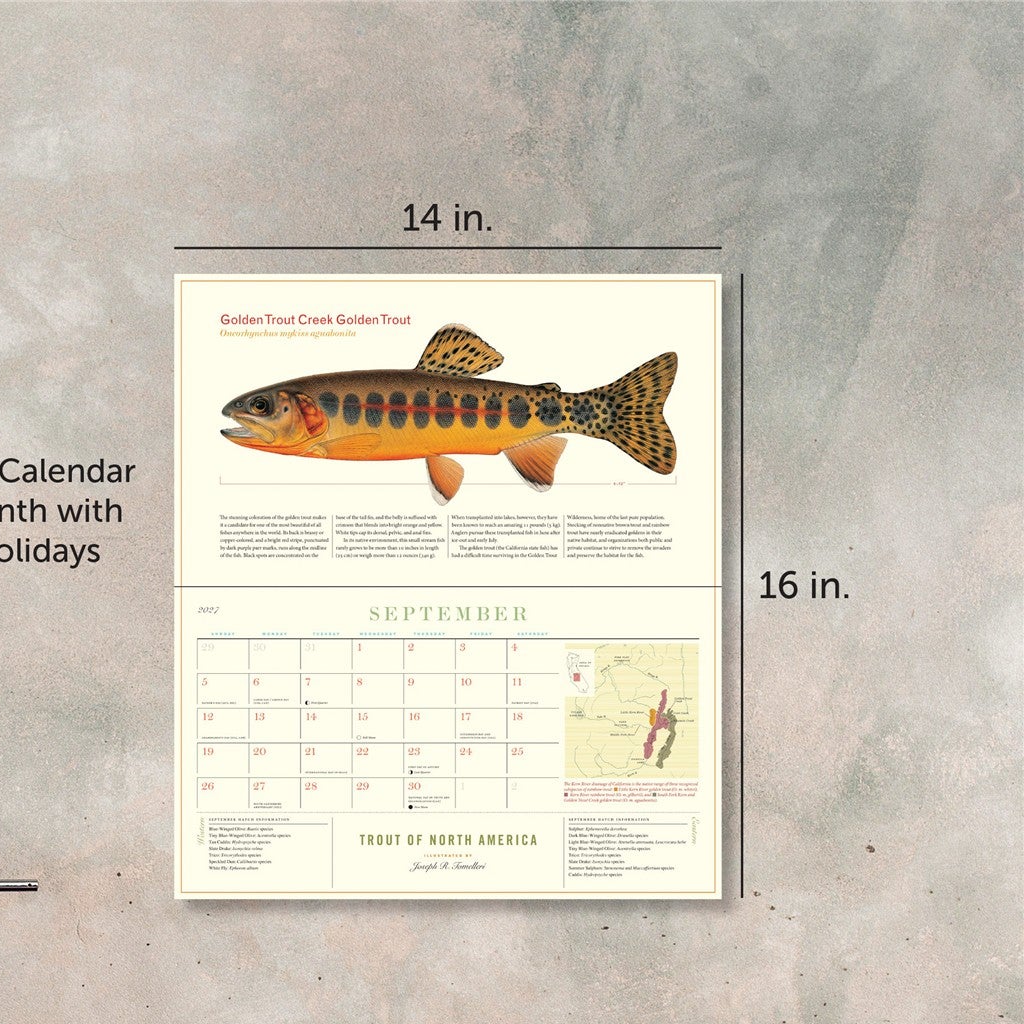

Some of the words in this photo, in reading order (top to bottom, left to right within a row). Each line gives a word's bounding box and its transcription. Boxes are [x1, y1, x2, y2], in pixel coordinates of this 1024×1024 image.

[220, 314, 263, 325] Golden
[264, 314, 295, 325] Trout
[298, 314, 333, 325] Creek
[336, 314, 379, 325] Golden
[380, 314, 411, 325] Trout
[219, 329, 278, 339] Oncorhynchus
[280, 329, 309, 339] mykiss
[198, 606, 219, 614] 2027
[370, 607, 526, 621] SEPTEMBER
[358, 643, 361, 652] 1
[408, 643, 414, 652] 2
[459, 643, 466, 652] 3
[512, 643, 517, 652] 4
[202, 678, 208, 686] 5
[305, 678, 311, 686] 7
[408, 678, 415, 686] 9
[461, 678, 472, 686] 10
[513, 678, 522, 686] 11
[203, 712, 214, 721] 12
[255, 712, 265, 721] 13
[306, 712, 317, 721] 14
[358, 712, 368, 721] 15
[410, 712, 420, 721] 16
[461, 712, 471, 721] 17
[513, 712, 523, 721] 18
[203, 747, 214, 756] 19
[253, 748, 266, 756] 20
[304, 747, 315, 756] 21
[356, 747, 369, 756] 22
[408, 747, 420, 756] 23
[460, 747, 472, 756] 24
[511, 747, 524, 756] 25
[201, 782, 214, 790] 26
[253, 782, 265, 791] 27
[304, 782, 318, 790] 28
[356, 782, 370, 790] 29
[408, 782, 421, 790] 30
[359, 834, 401, 846] TROUT
[407, 834, 423, 846] OF
[429, 834, 472, 846] NORTH
[478, 834, 537, 846] AMERICA
[409, 862, 438, 873] Joseph
[439, 861, 449, 870] R.
[451, 861, 486, 870] Tomelleri
